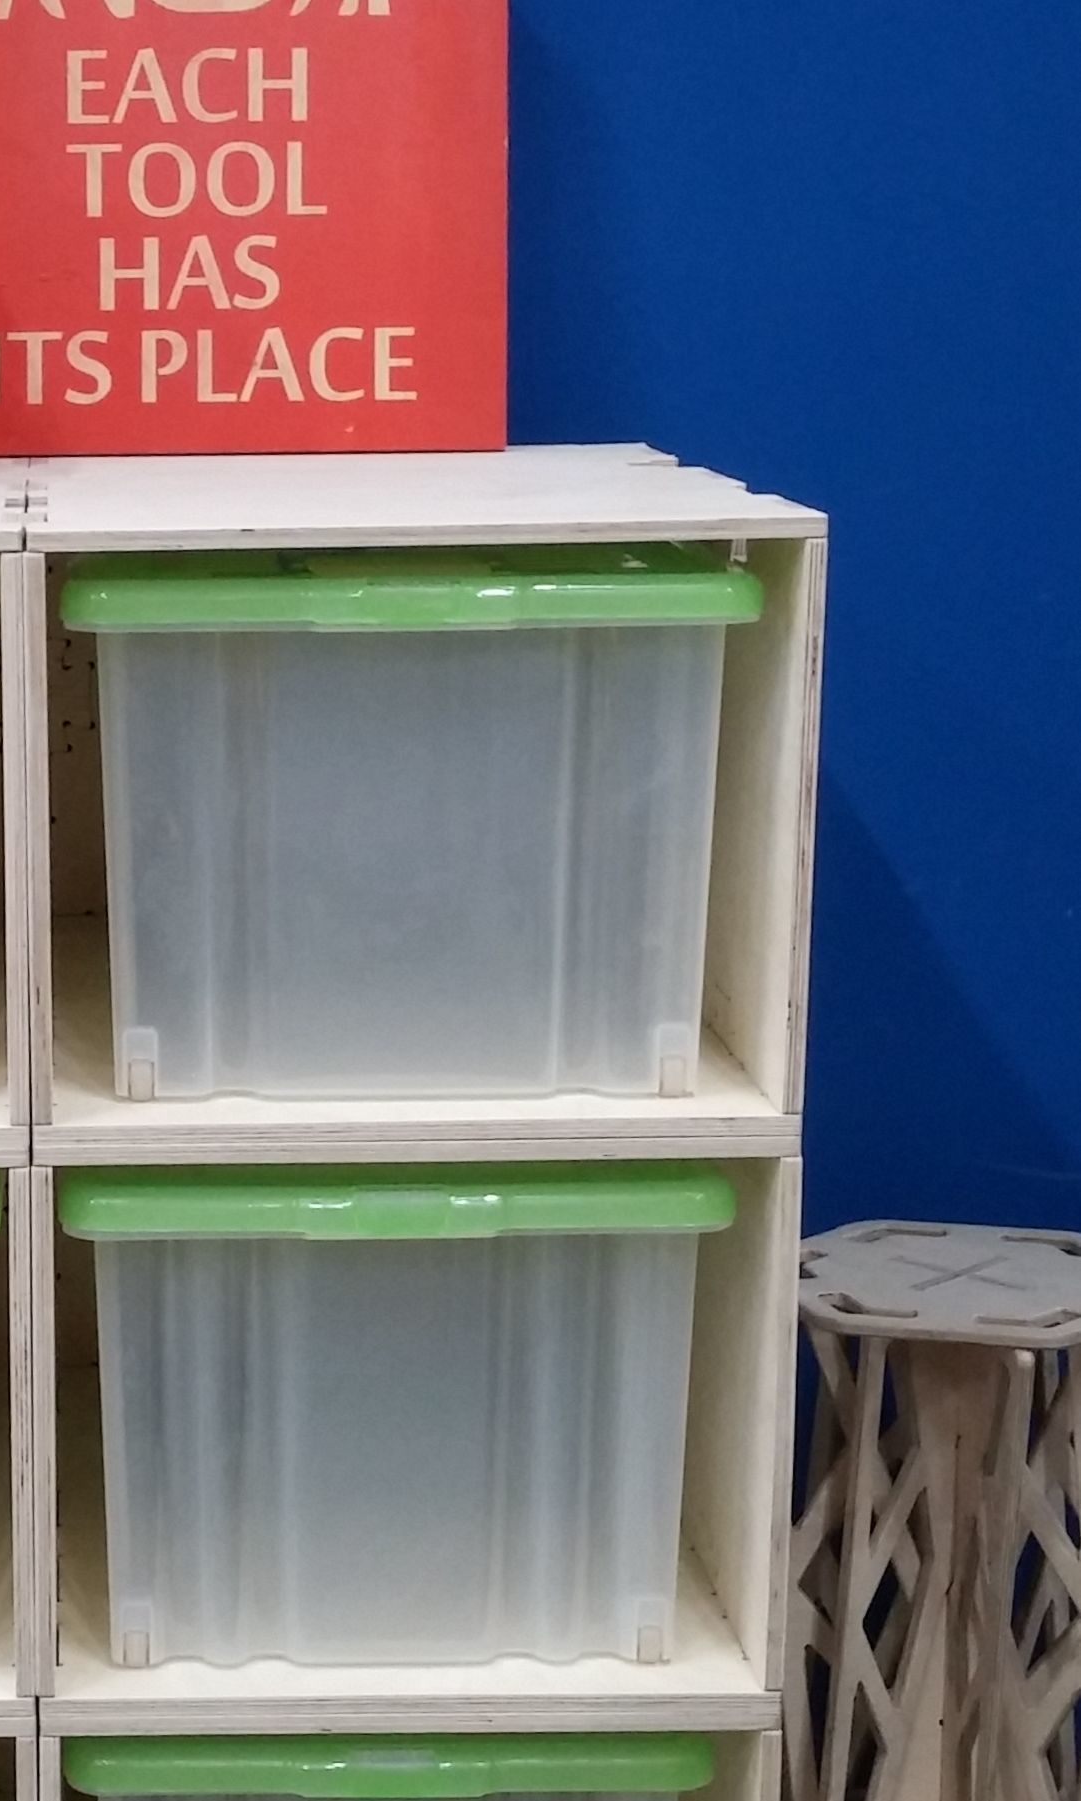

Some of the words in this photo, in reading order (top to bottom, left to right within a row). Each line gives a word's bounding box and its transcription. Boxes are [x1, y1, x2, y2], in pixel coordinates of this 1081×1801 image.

[66, 47, 309, 125] EACH
[65, 141, 328, 218] TOOL
[98, 235, 281, 312] HAS
[140, 326, 418, 404] PLACE
